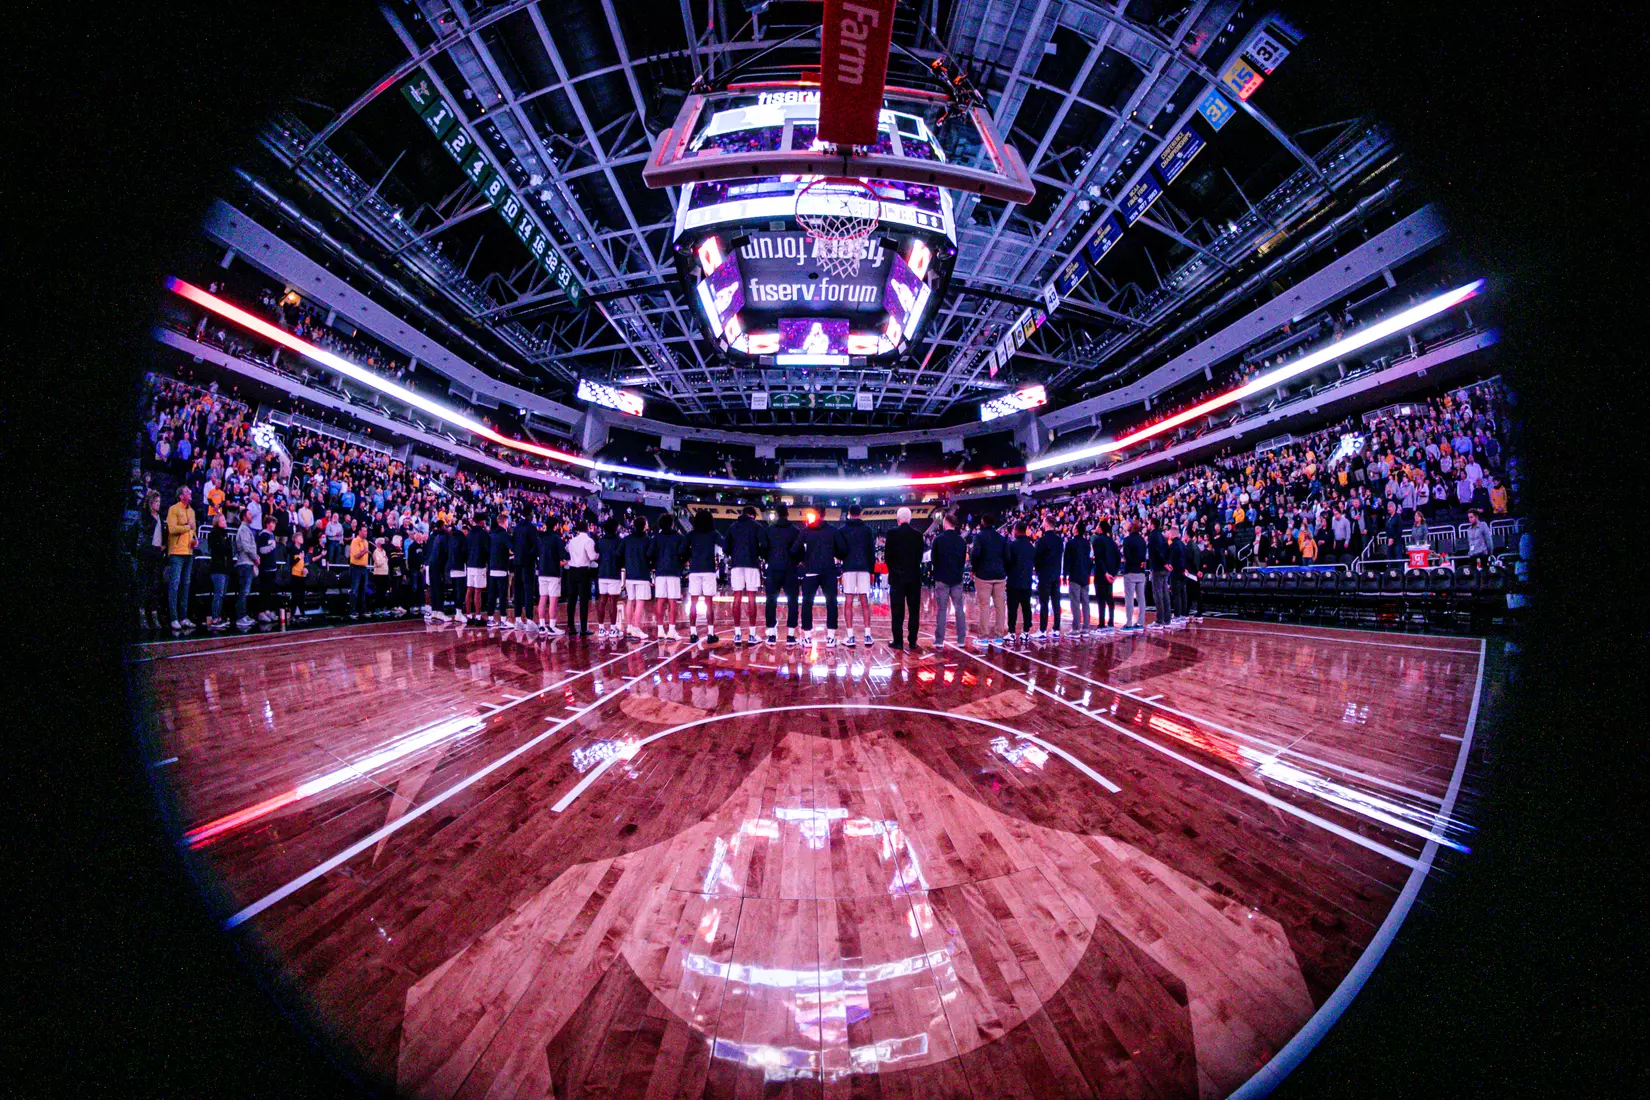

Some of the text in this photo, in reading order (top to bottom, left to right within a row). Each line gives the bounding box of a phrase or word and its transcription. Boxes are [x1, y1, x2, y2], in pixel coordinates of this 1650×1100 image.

[838, 2, 880, 85] Farm
[1256, 38, 1280, 63] 31
[1230, 66, 1255, 91] 15
[758, 91, 820, 106] fiserv
[432, 109, 447, 125] 1
[1205, 98, 1229, 122] 31
[451, 134, 467, 153] 2
[1160, 131, 1184, 159] CONFERENCE
[1160, 131, 1192, 168] CHAMPIONSHIPS
[471, 160, 484, 175] 4
[488, 181, 502, 196] 8
[502, 198, 519, 219] 10
[518, 218, 533, 238] 14
[531, 236, 546, 255] 16
[544, 251, 559, 271] 32
[557, 267, 572, 286] 33
[1049, 292, 1057, 303] 43
[862, 508, 928, 516] MARQTTE
